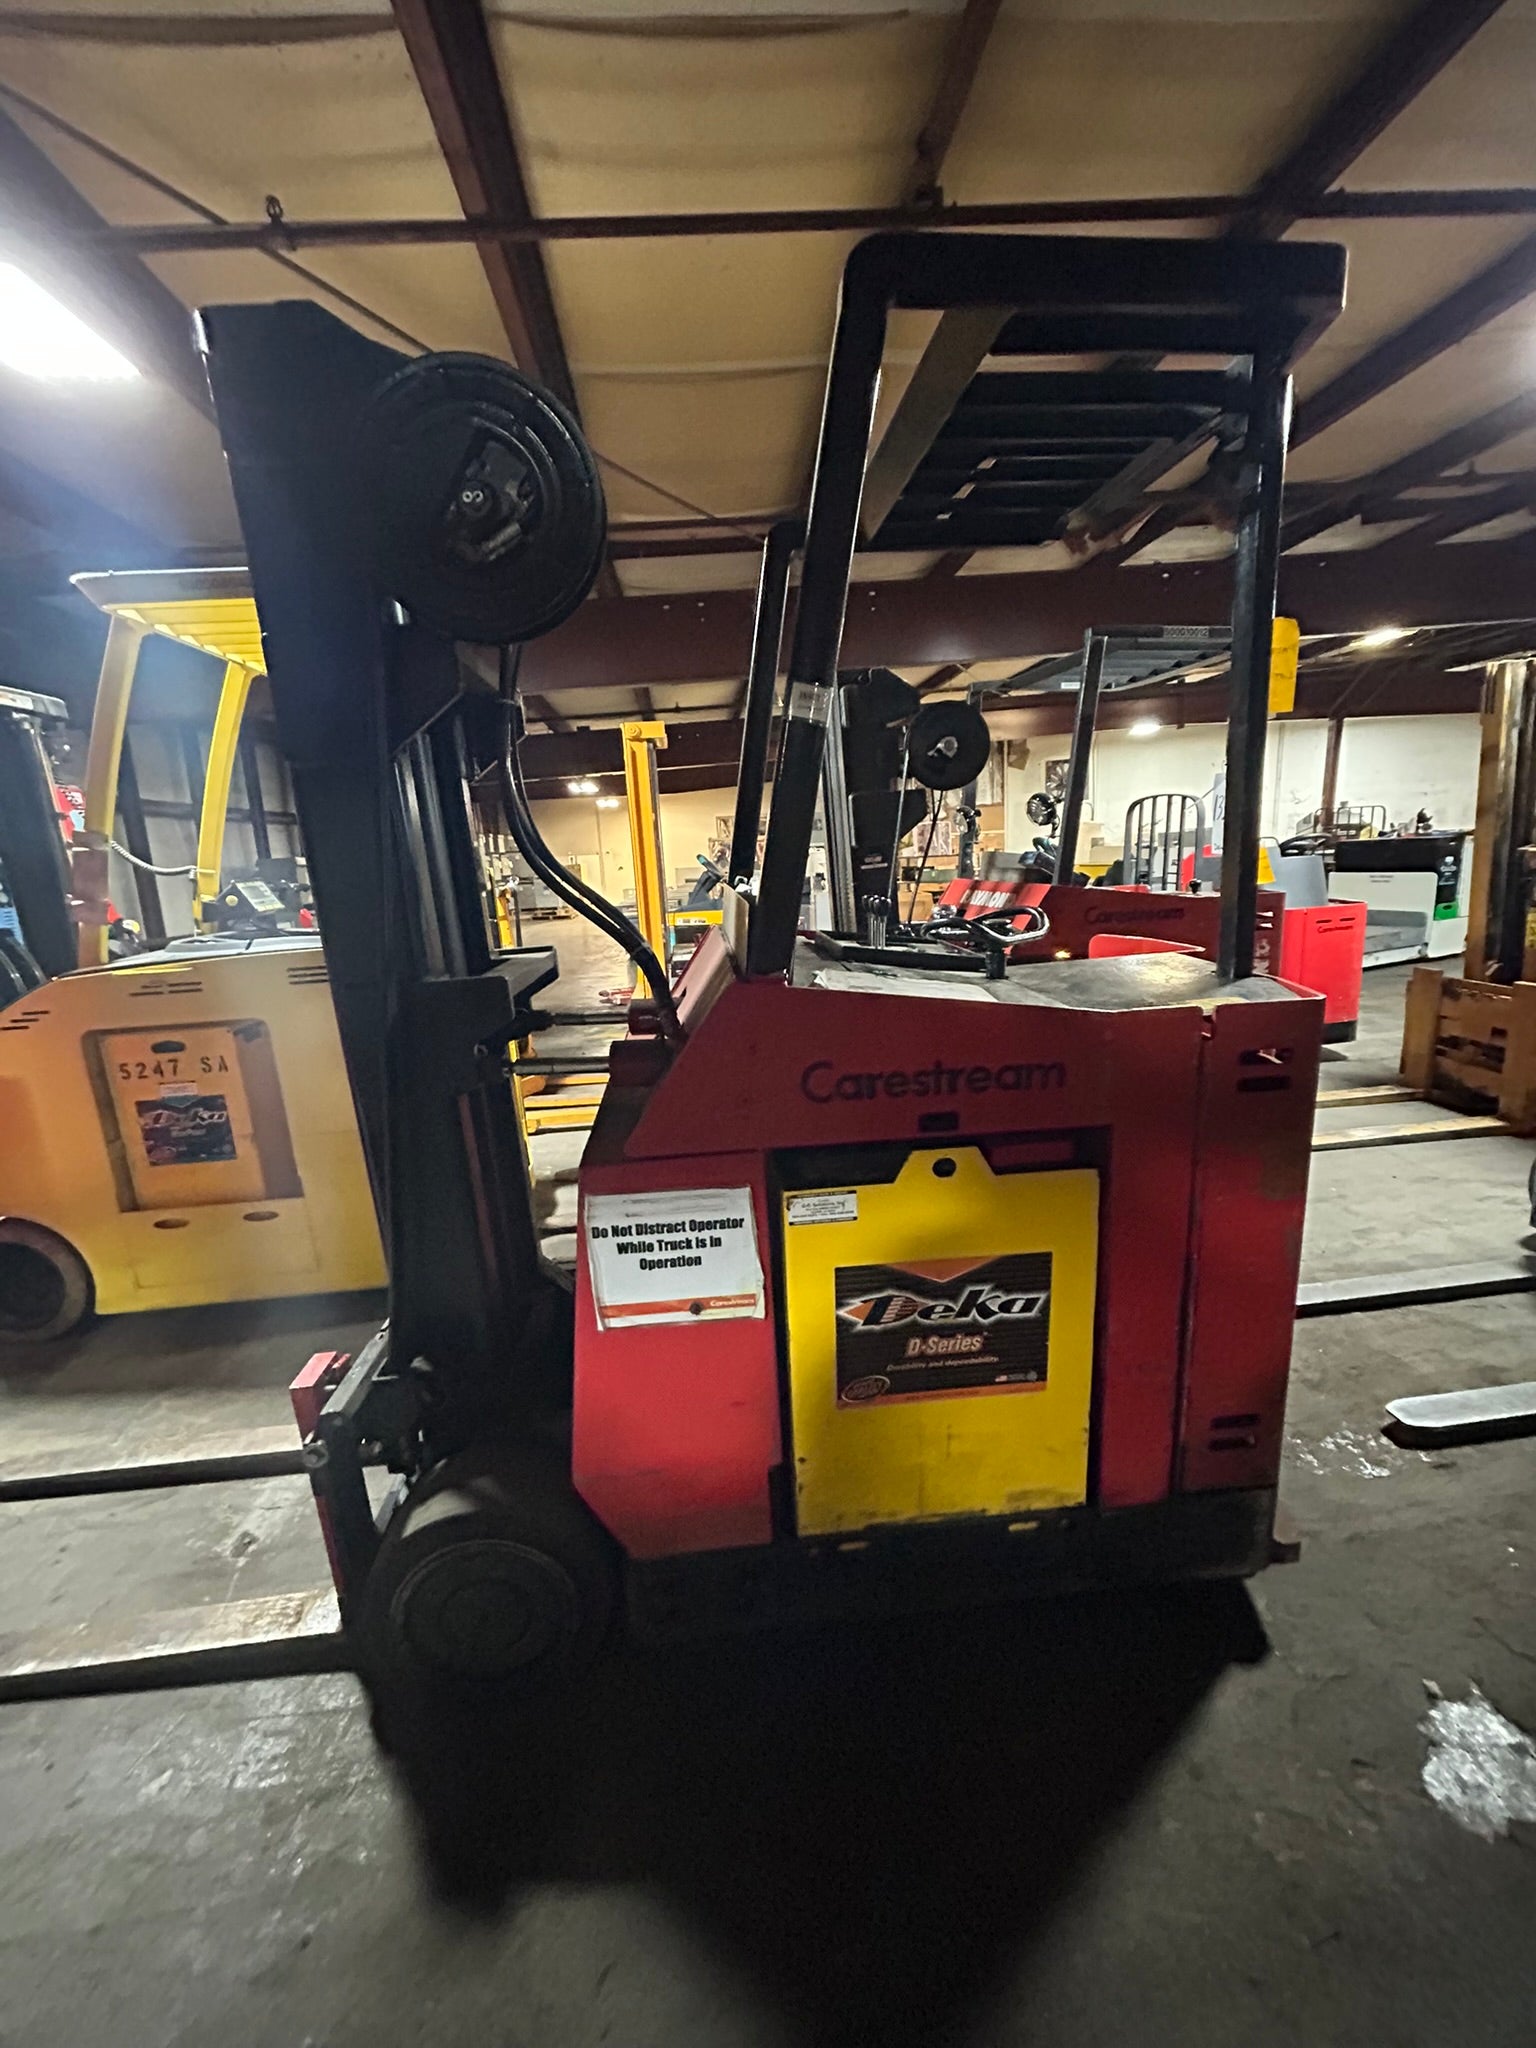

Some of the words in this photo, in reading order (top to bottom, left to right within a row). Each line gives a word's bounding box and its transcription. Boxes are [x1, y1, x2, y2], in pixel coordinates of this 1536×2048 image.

[119, 1058, 179, 1080] 5247
[200, 1055, 229, 1074] SA
[800, 1059, 1067, 1104] Carestream
[592, 1226, 608, 1239] Do
[611, 1224, 633, 1238] Not
[635, 1220, 687, 1236] Distract
[689, 1217, 744, 1233] Operator
[616, 1240, 654, 1255] While
[656, 1237, 693, 1252] Truck
[695, 1236, 707, 1249] is
[709, 1235, 722, 1248] in
[639, 1255, 702, 1271] Operation
[842, 1285, 1048, 1329] Deka
[907, 1334, 983, 1356] D-Series
